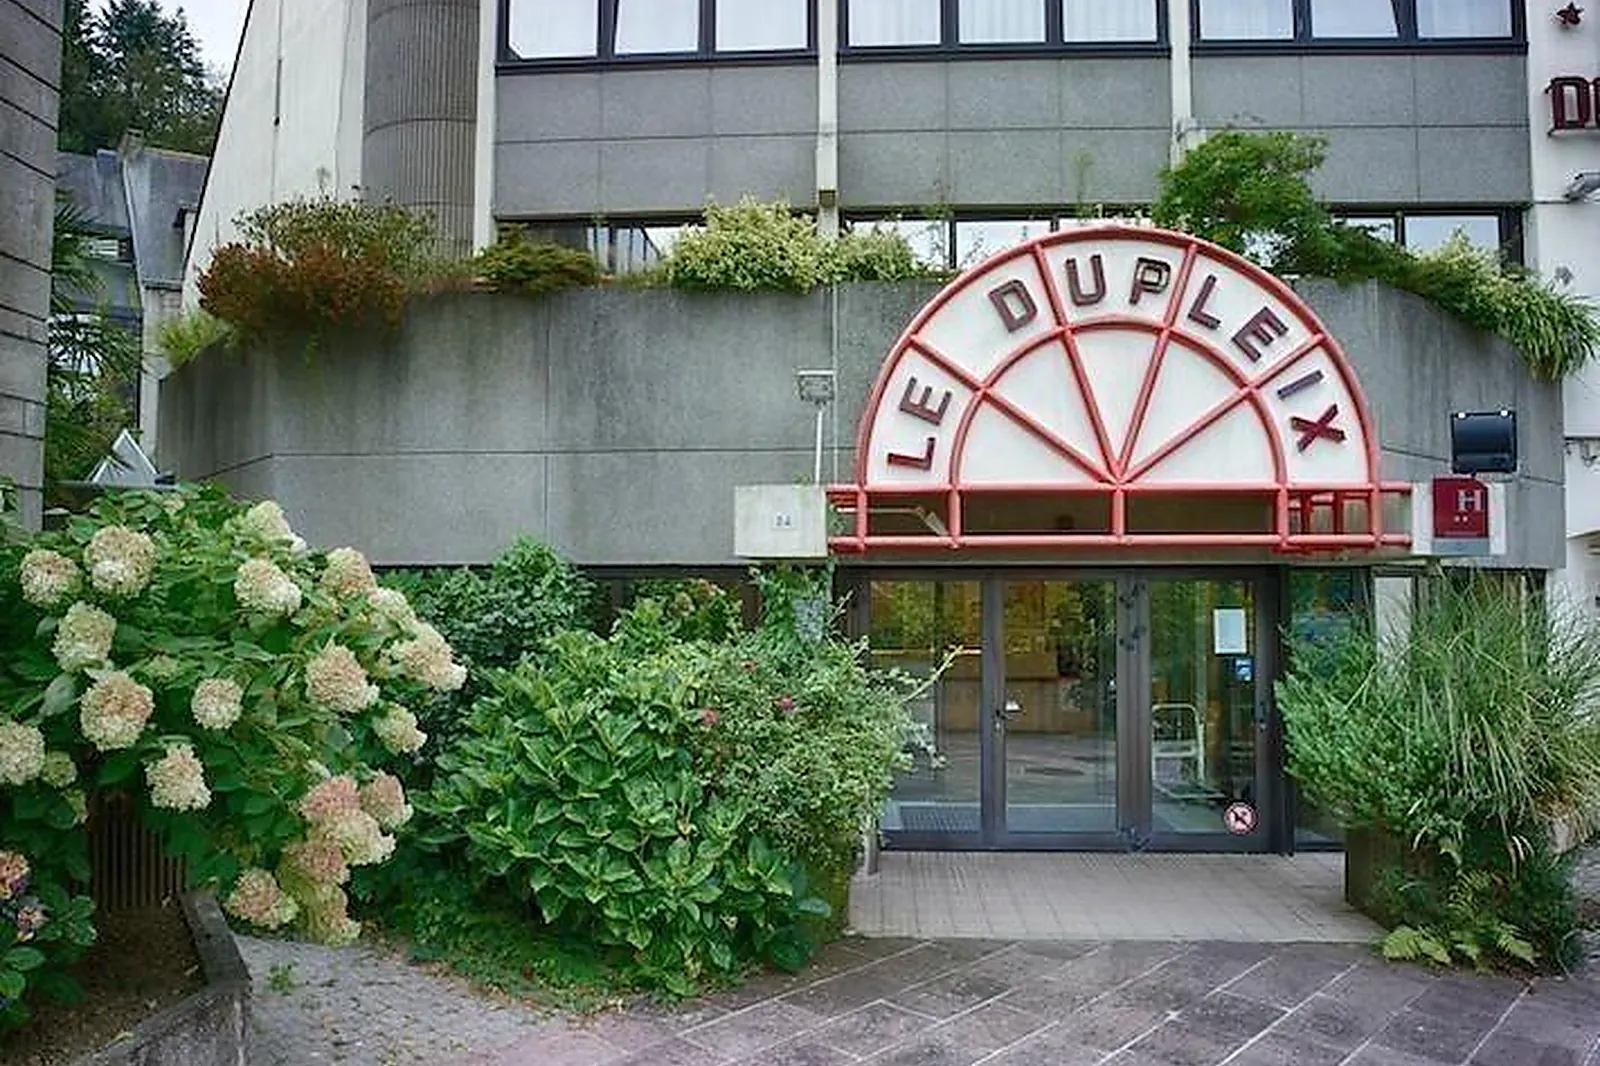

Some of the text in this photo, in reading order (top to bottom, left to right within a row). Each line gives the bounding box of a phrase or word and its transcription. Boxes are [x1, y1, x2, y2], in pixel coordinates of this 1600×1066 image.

[887, 253, 1347, 471] LE DUPLEIX
[1457, 489, 1482, 512] H
